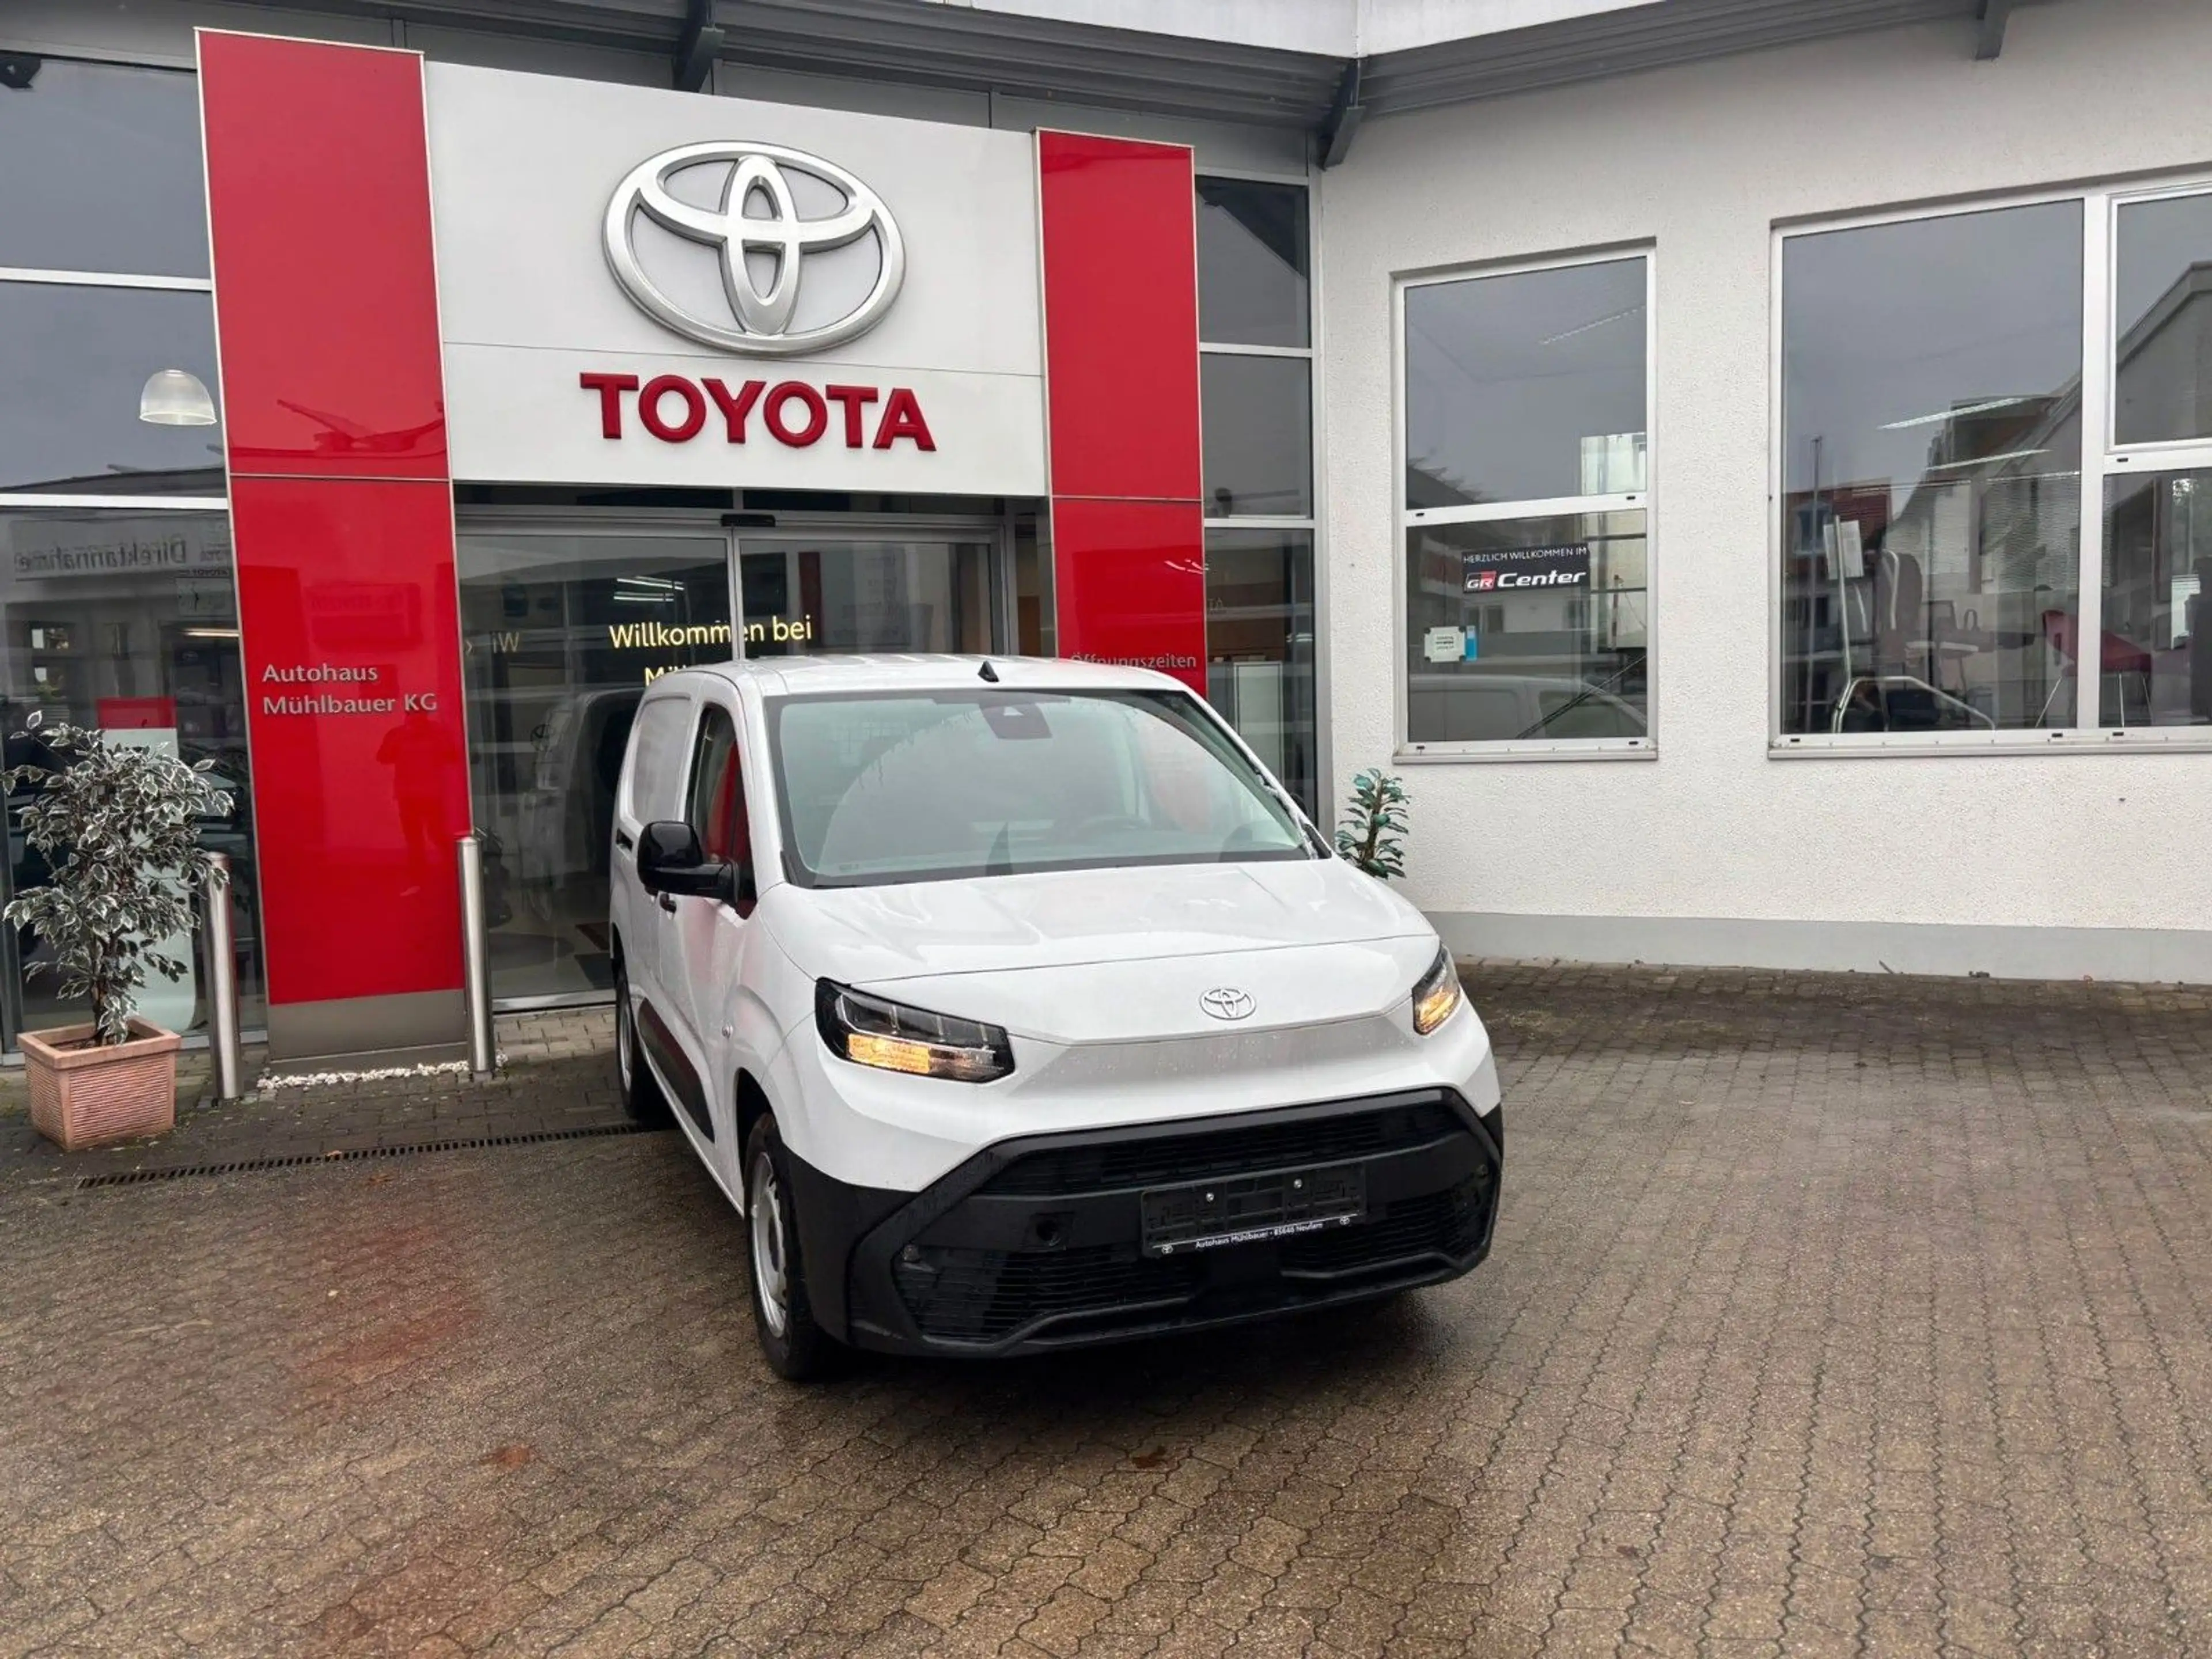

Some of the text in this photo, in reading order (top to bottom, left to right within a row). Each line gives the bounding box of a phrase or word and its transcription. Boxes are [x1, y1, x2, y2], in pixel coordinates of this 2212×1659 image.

[579, 372, 937, 452] TOYOTA
[1464, 547, 1587, 563] HERZLICH WILLKOMMEN IM
[1498, 570, 1586, 588] Center
[772, 615, 812, 641] bei
[262, 663, 378, 682] Autohaus
[263, 693, 437, 714] Mühlbauer KG
